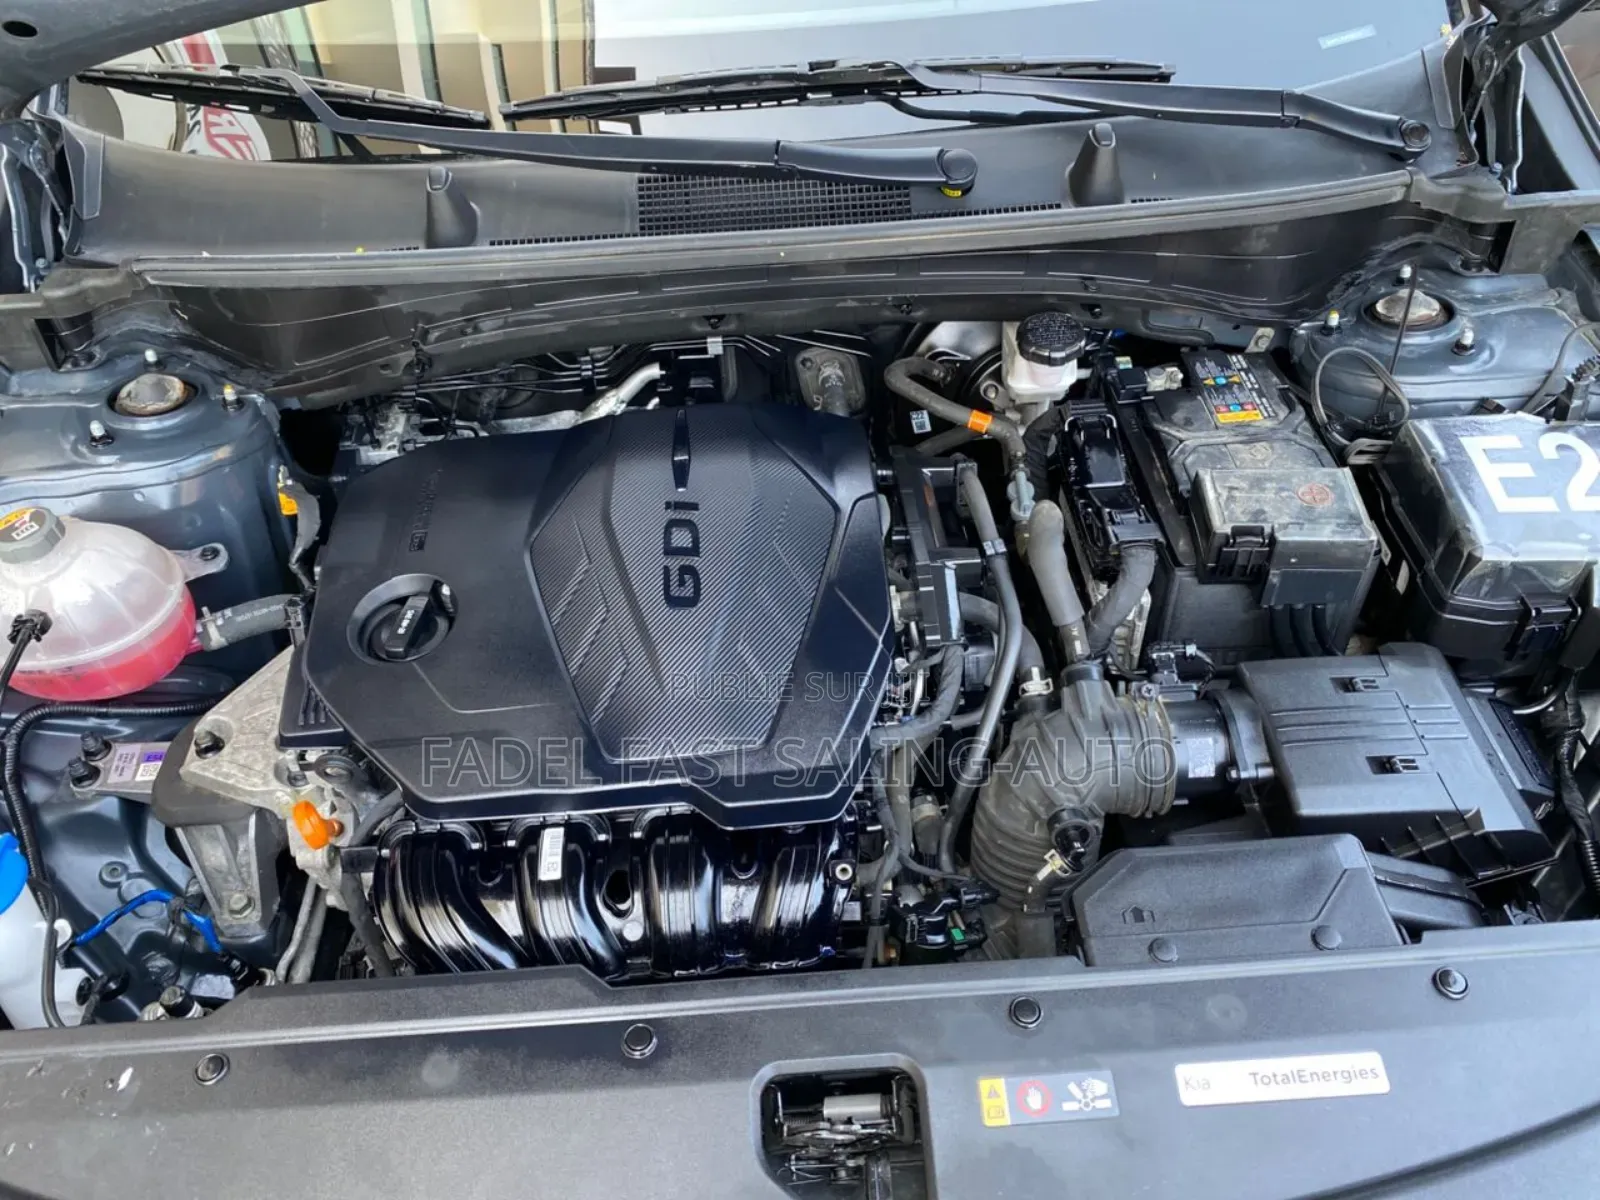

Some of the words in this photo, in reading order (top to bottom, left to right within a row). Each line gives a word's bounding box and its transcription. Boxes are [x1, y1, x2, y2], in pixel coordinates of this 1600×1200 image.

[1458, 431, 1600, 513] E2
[663, 501, 701, 609] GDi
[1183, 1075, 1211, 1092] Kia
[1249, 1064, 1380, 1086] TotalEnergies
